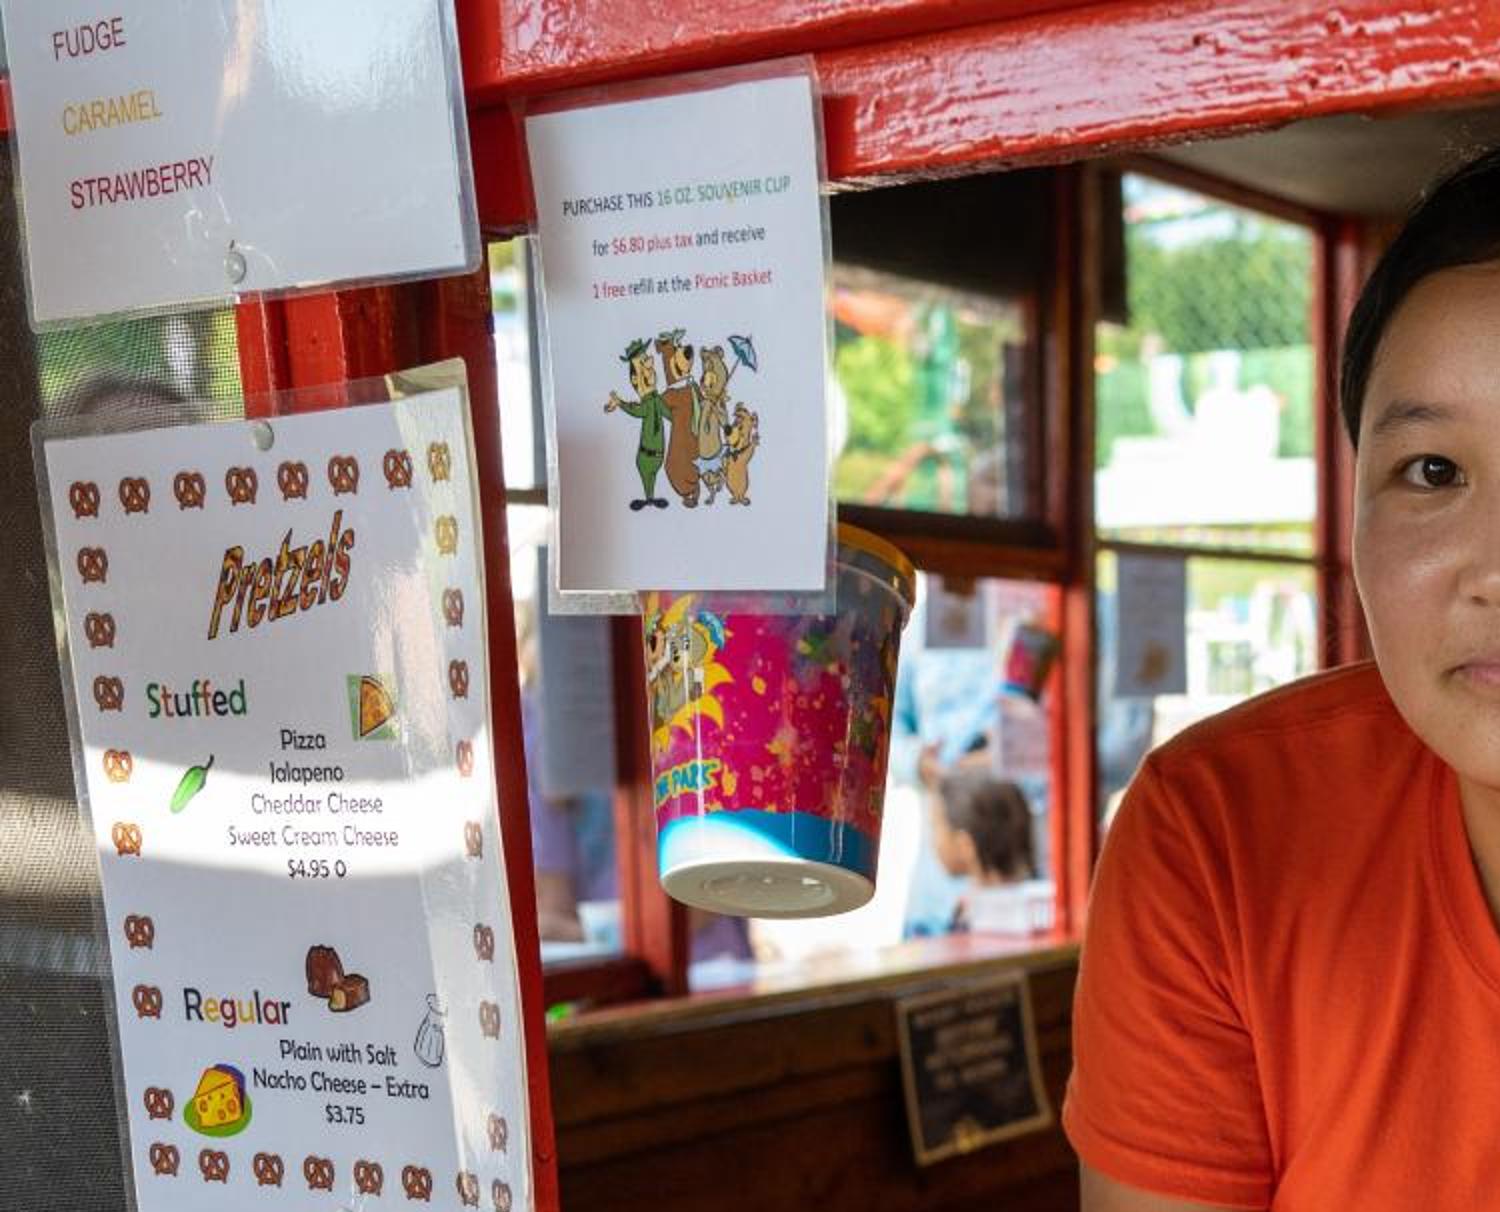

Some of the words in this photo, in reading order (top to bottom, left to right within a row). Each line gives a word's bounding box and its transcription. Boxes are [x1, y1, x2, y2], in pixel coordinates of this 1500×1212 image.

[53, 17, 126, 61] FUDGE
[62, 90, 162, 135] CARAMEL
[70, 155, 214, 210] STRAWBERRY
[562, 195, 624, 216] PURCHASE
[628, 192, 652, 208] THIS
[657, 189, 672, 206] 16
[697, 179, 761, 200] SOUVENIR
[765, 175, 791, 194] CUP
[592, 239, 609, 256] for
[611, 235, 644, 254] $6.80
[647, 235, 672, 253] plus
[675, 234, 693, 249] tax
[695, 230, 718, 247] and
[722, 226, 765, 244] receive
[593, 283, 600, 299] 1
[602, 281, 625, 298] free
[629, 277, 654, 295] refill
[657, 279, 668, 293] at
[671, 275, 691, 292] the
[695, 272, 729, 289] Picnic
[732, 269, 772, 287] Basket
[208, 510, 354, 640] Pretzels
[147, 679, 246, 719] Stuffed
[280, 729, 326, 750] Pizza
[270, 761, 344, 786] Jalapeno
[251, 793, 322, 814] Cheddar
[327, 792, 383, 813] Cheese
[228, 825, 277, 846] Sweet
[282, 825, 338, 846] Cream
[343, 825, 399, 846] Cheese
[287, 859, 329, 879] $4.95
[183, 987, 291, 1028] Regular
[279, 1039, 322, 1061] Plain
[326, 1043, 362, 1064] with
[366, 1044, 397, 1066] Salt
[253, 1067, 306, 1091] Nacho
[311, 1071, 366, 1094] Cheese
[385, 1075, 429, 1099] Extra
[325, 1103, 365, 1125] $3.75
